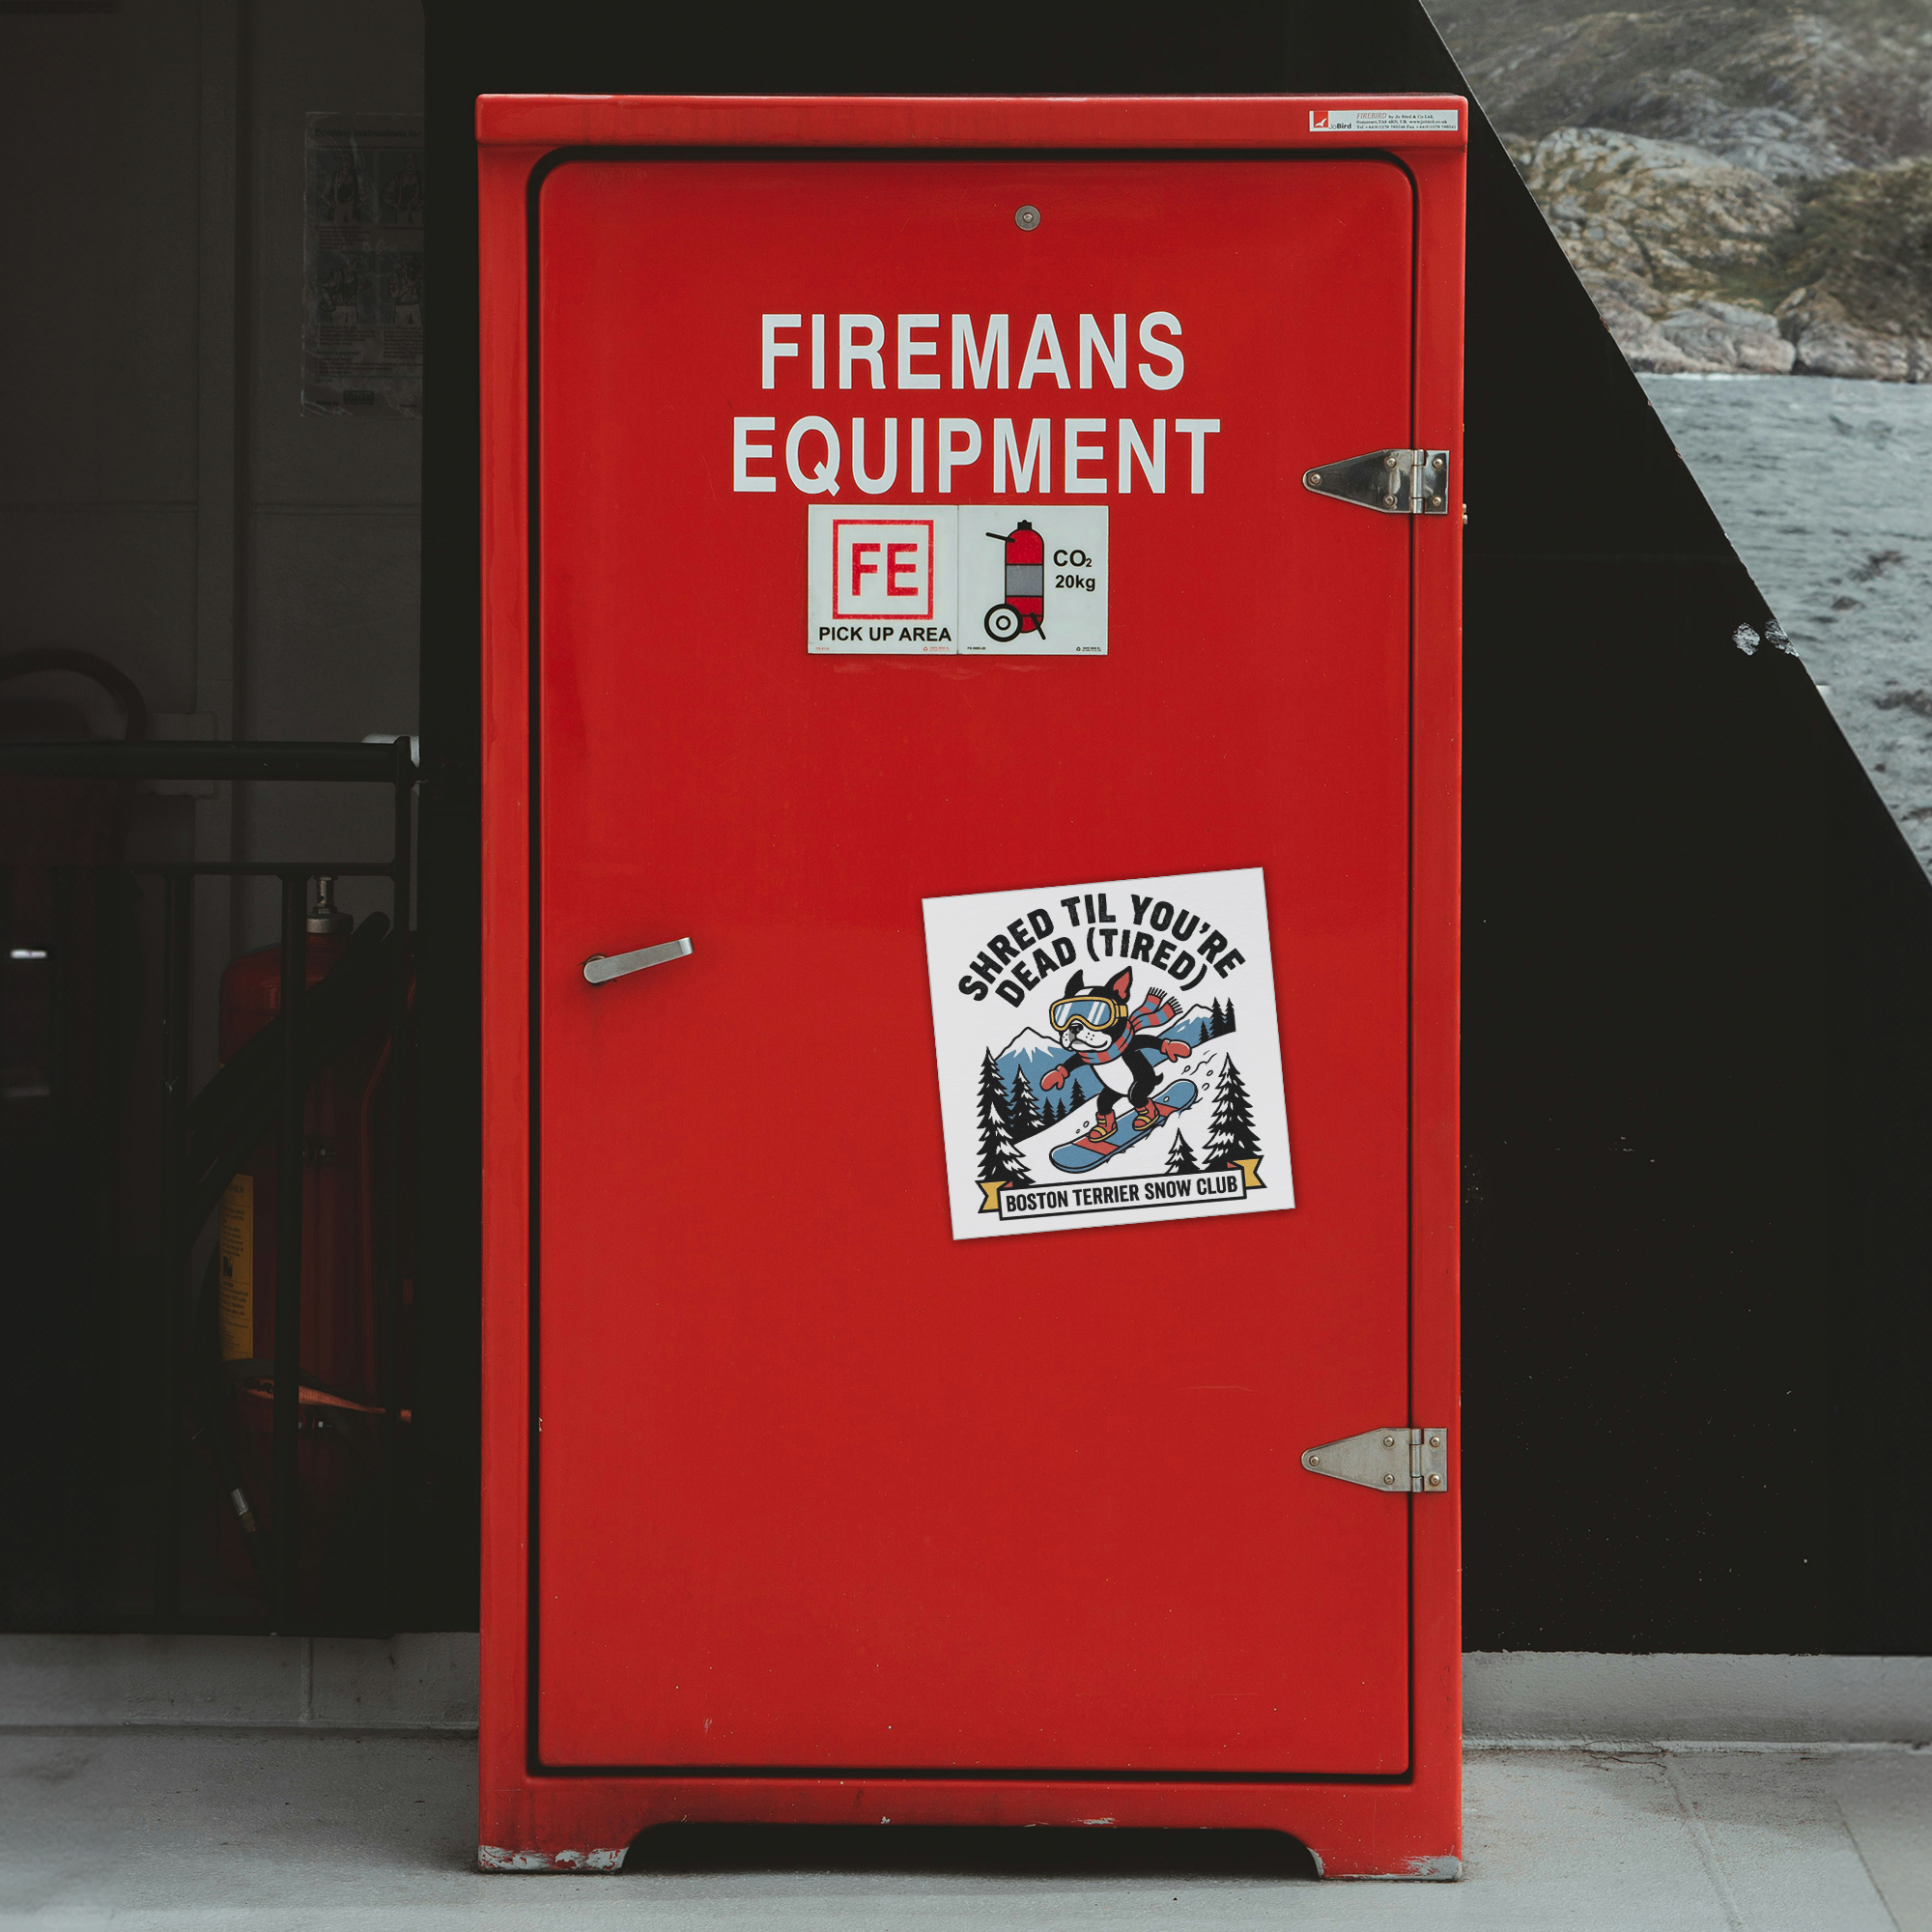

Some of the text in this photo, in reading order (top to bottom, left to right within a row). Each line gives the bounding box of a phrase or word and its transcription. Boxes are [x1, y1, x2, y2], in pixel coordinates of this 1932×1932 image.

[315, 128, 351, 138] Donning
[762, 312, 1184, 390] FIREMANS
[733, 415, 1221, 497] EQUIPMENT
[851, 543, 919, 596] FE
[1055, 574, 1096, 592] 20kg
[819, 626, 952, 641] PICK UP AREA
[958, 893, 1246, 1002] SHRED TIL YOU'RE
[995, 927, 1208, 1008] DEAD (TIRED)
[1006, 1176, 1238, 1212] BOSTON TERRIER SNOW CLUB
